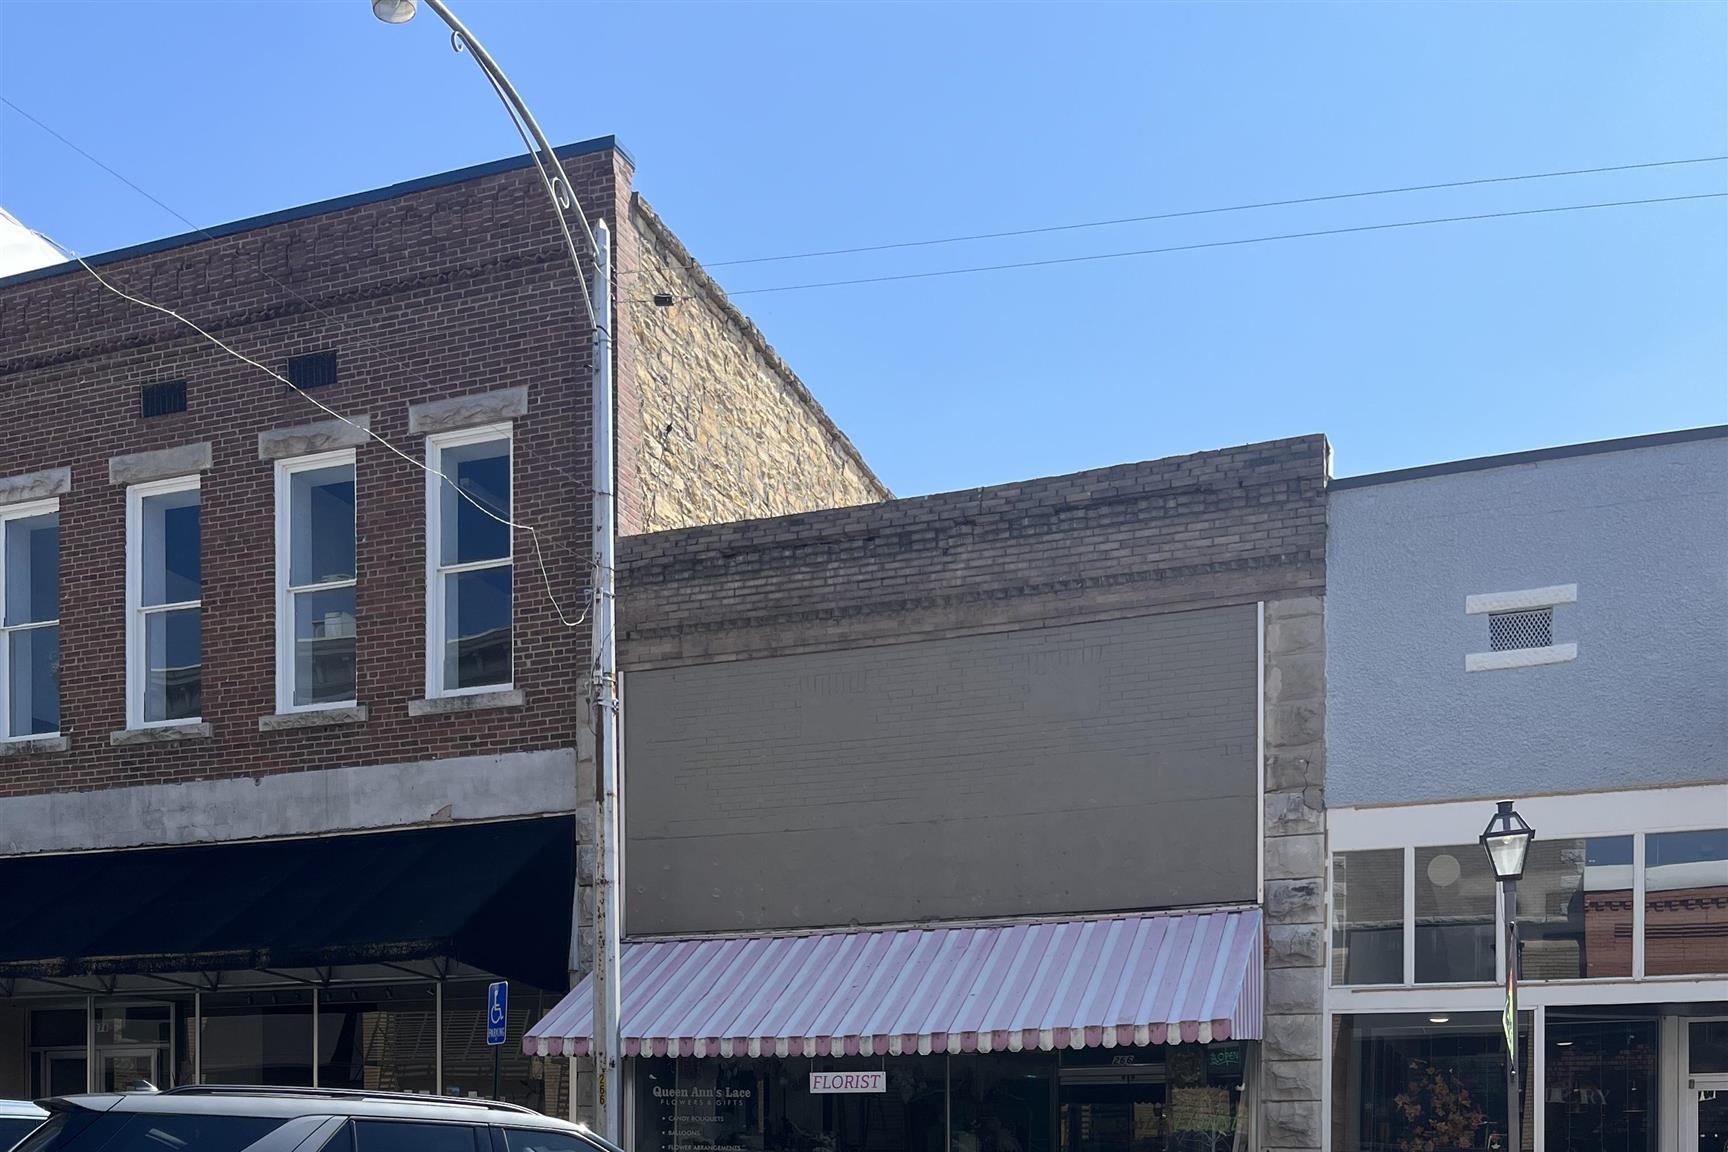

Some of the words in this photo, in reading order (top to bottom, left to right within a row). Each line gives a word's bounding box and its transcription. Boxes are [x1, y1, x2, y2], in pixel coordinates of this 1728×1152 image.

[813, 1074, 881, 1089] FLORIST
[652, 1086, 688, 1098] Queen
[691, 1086, 722, 1098] Ann's
[725, 1087, 751, 1098] Lace
[668, 1115, 690, 1123] CANDY
[693, 1144, 741, 1152] ARRANGEMENTS
